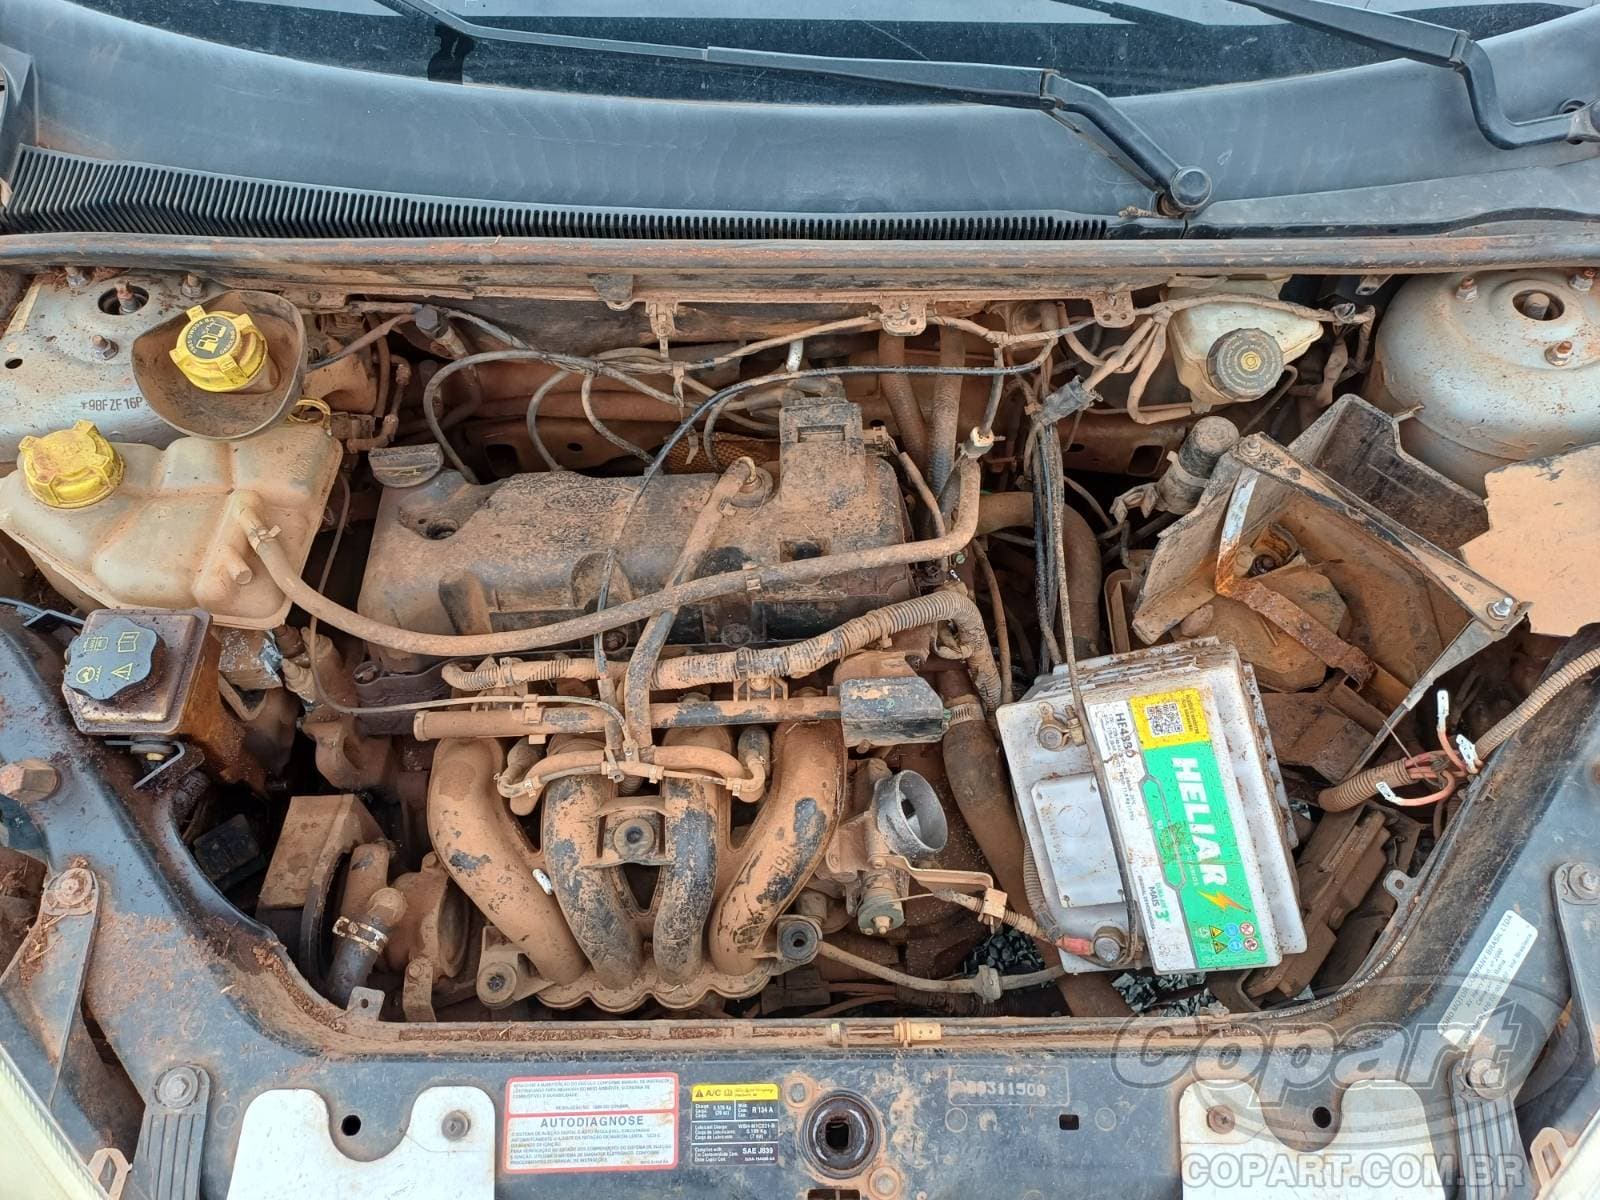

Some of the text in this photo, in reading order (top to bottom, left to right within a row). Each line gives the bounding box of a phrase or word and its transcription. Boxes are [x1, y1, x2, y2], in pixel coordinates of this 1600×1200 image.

[1172, 757, 1228, 886] HELIAR
[1149, 887, 1160, 907] MAIS
[1450, 986, 1470, 1011] MOTOR
[540, 1116, 644, 1128] AUTODIAGNOSE
